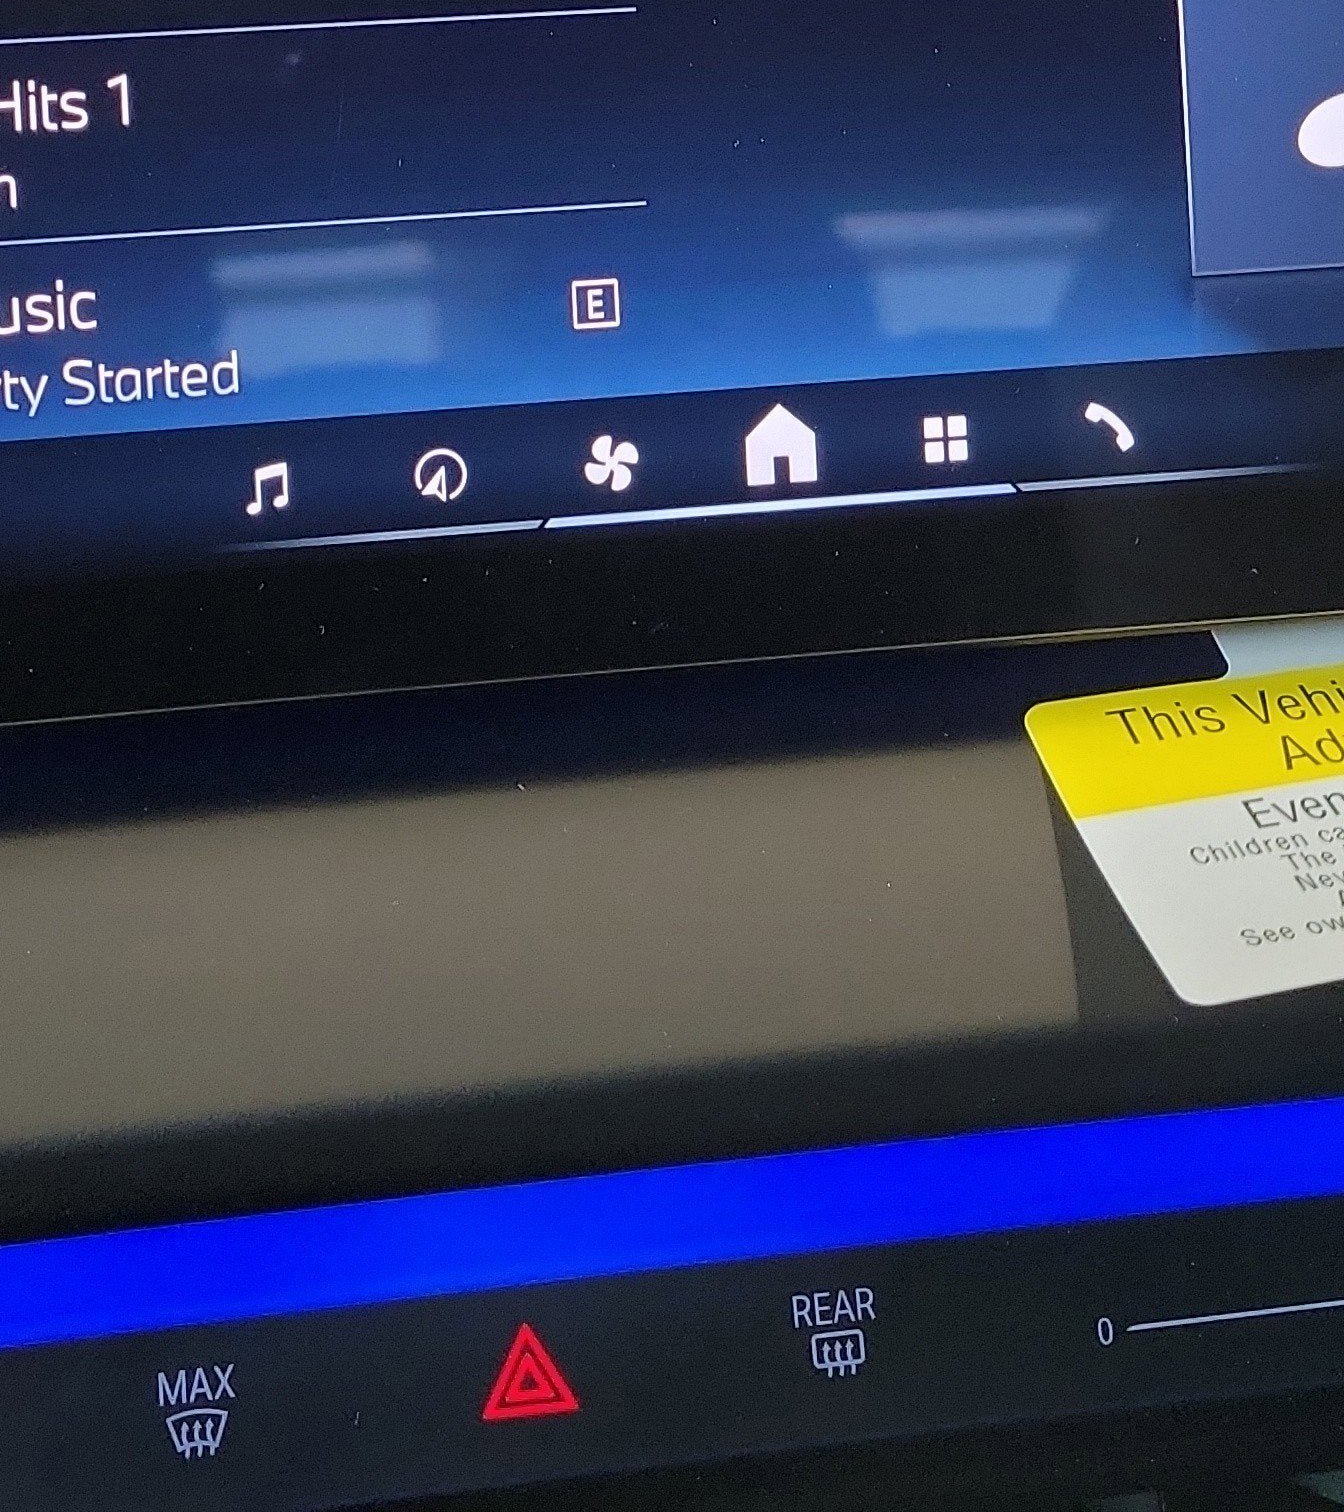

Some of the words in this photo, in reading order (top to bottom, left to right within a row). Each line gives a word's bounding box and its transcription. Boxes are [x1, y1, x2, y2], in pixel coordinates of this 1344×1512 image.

[106, 73, 130, 126] 1
[62, 349, 239, 406] Started
[1106, 699, 1225, 746] This
[1190, 832, 1308, 864] Children
[1280, 851, 1336, 871] The
[1240, 925, 1296, 946] See
[791, 1287, 876, 1329] REAR
[1097, 1317, 1114, 1346] 0
[157, 1363, 236, 1407] MAX
